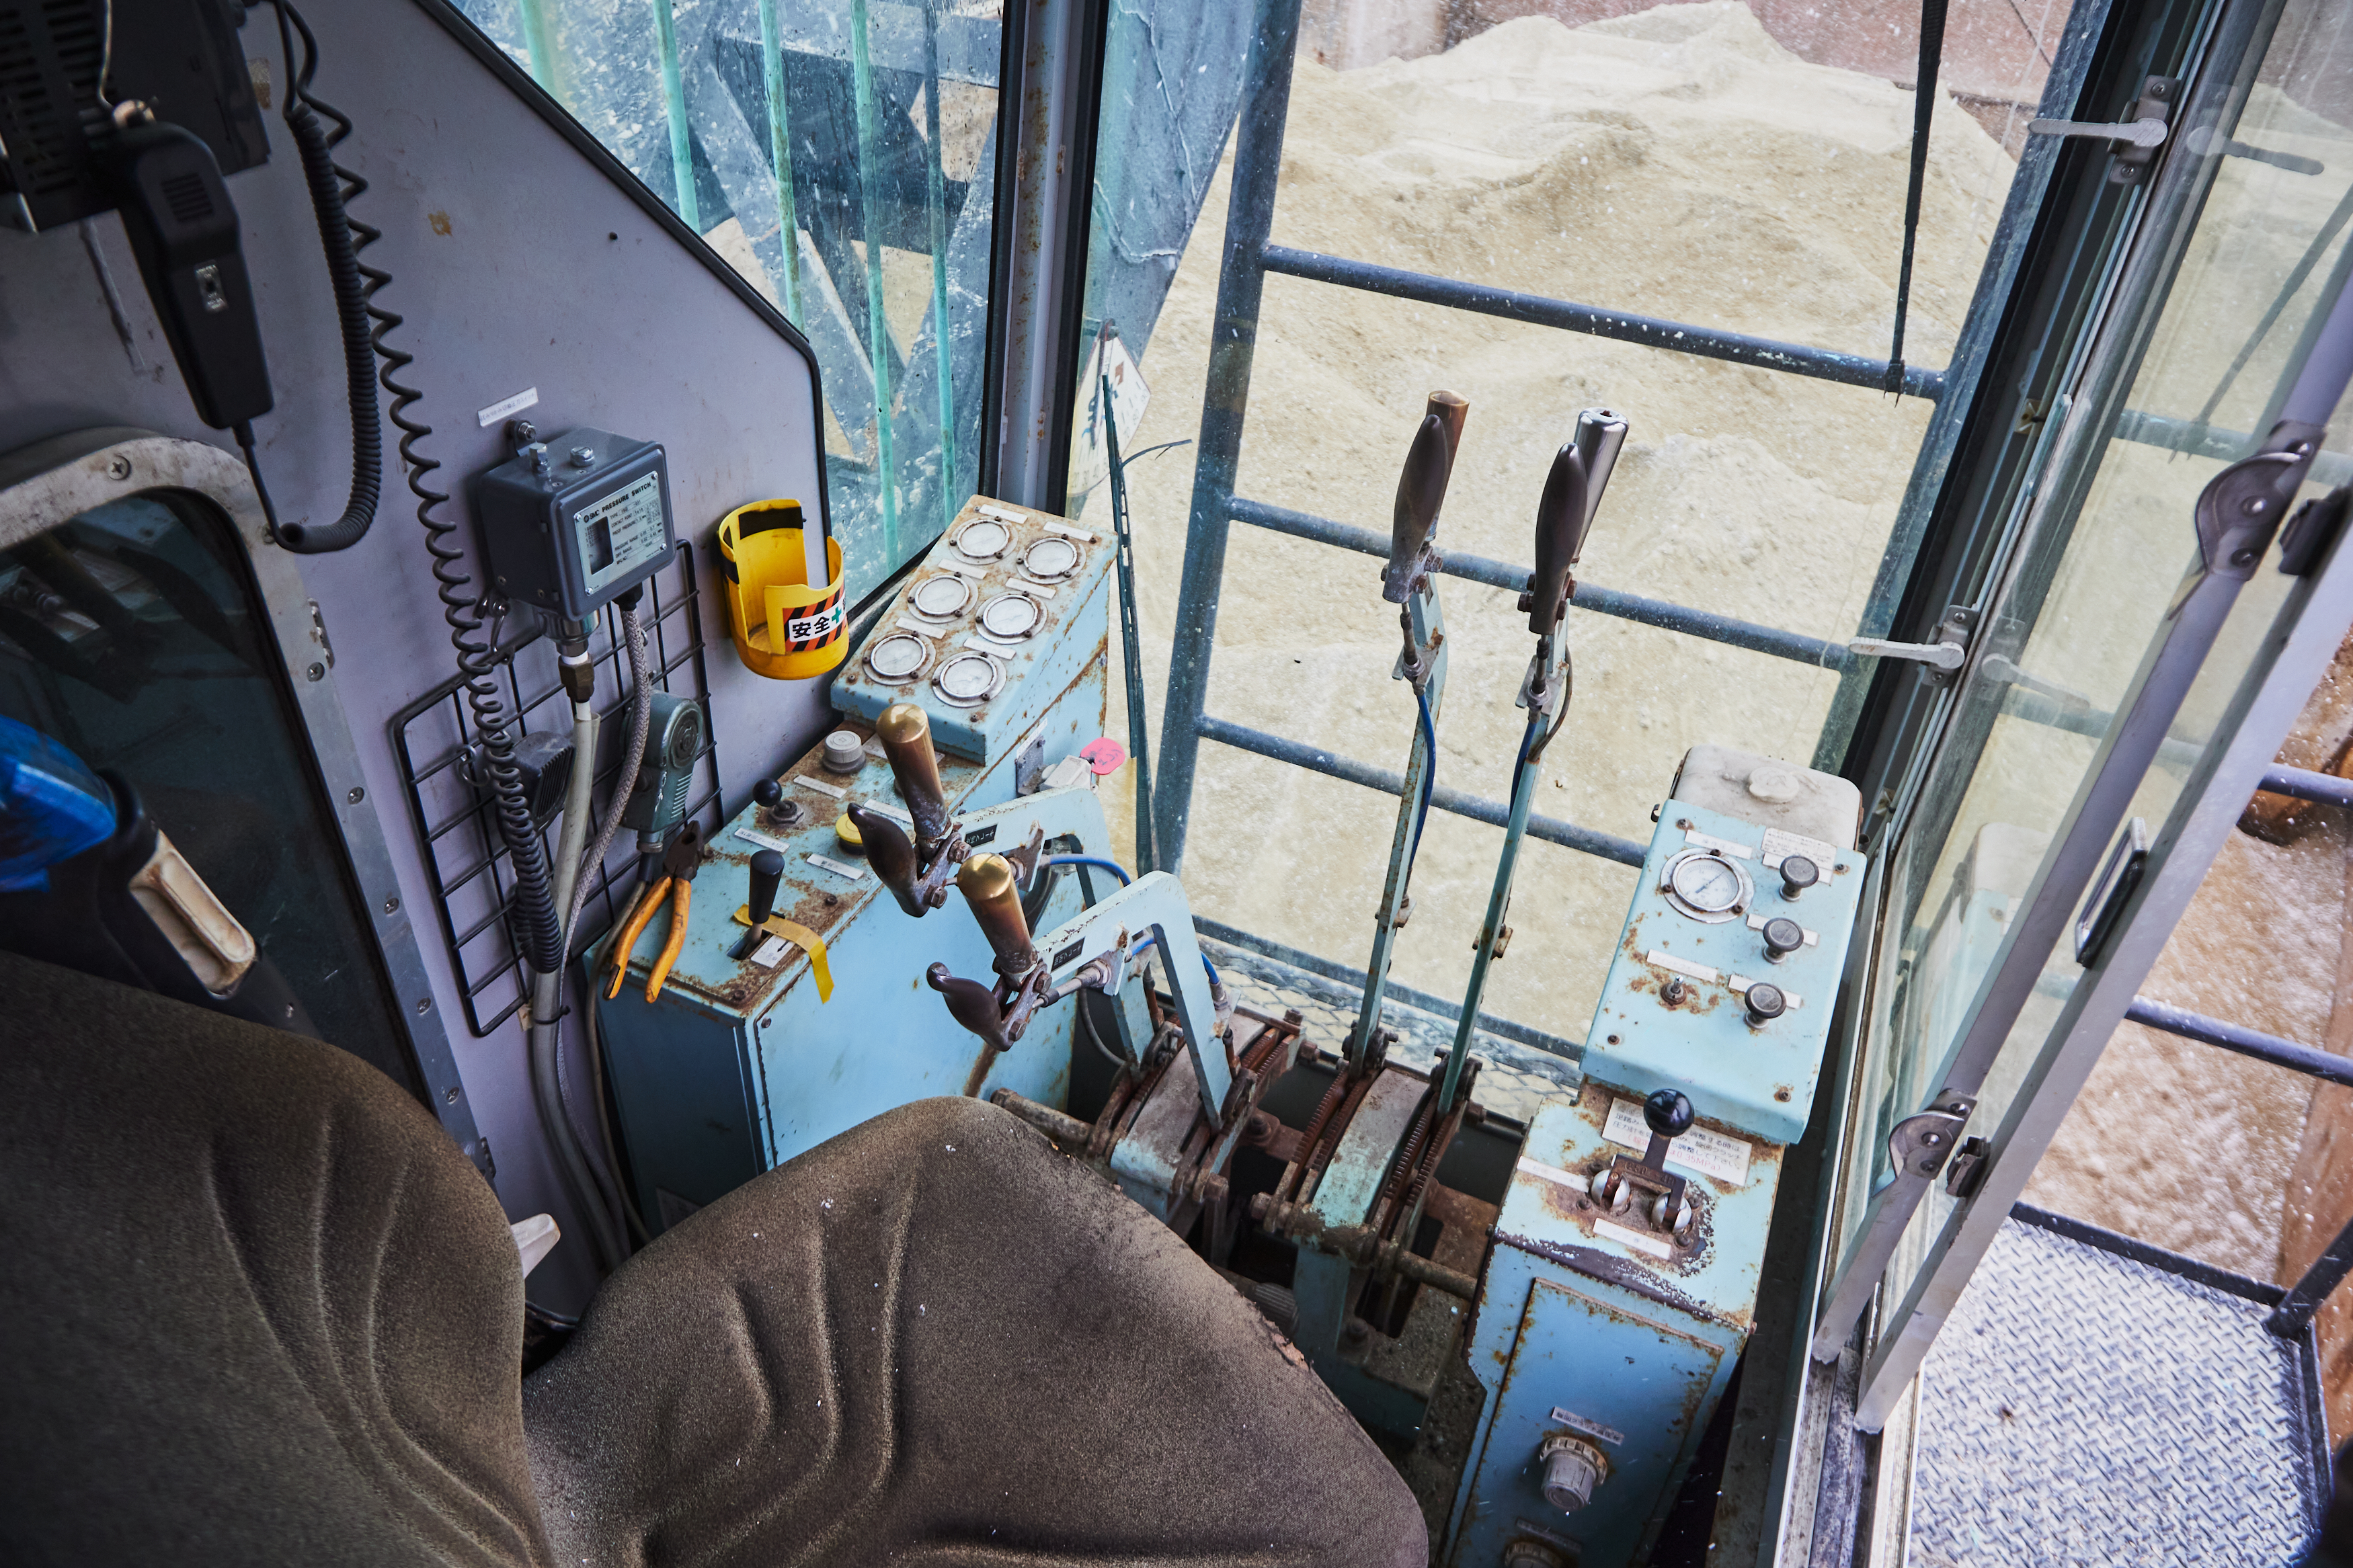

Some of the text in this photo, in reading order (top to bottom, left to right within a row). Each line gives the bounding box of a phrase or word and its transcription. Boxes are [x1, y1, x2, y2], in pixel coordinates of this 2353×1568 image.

[602, 493, 629, 512] PRESSURE
[631, 481, 651, 497] SWITCH
[792, 616, 831, 639] 安全
